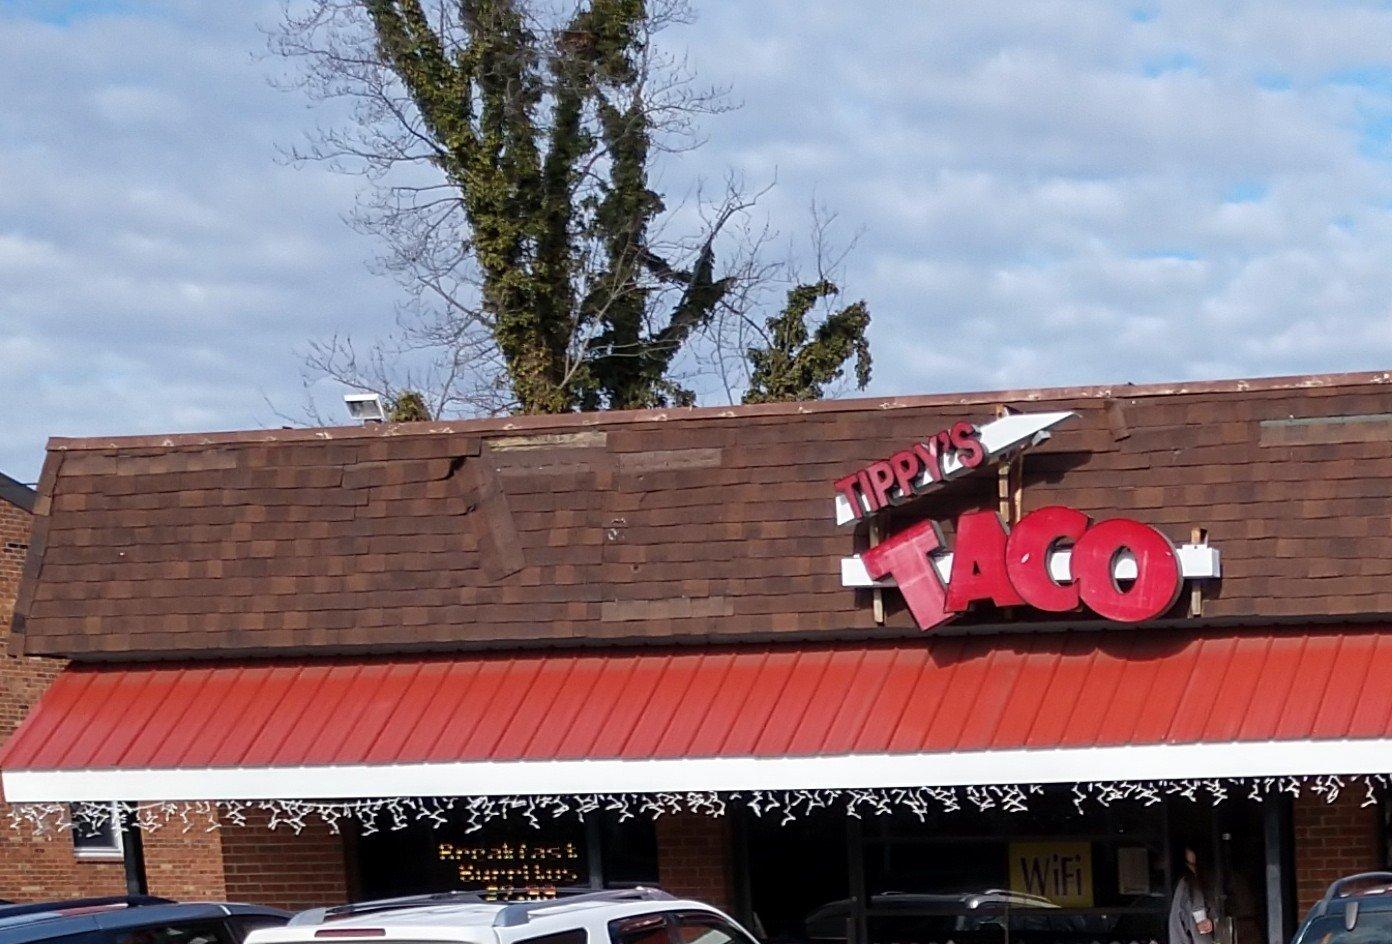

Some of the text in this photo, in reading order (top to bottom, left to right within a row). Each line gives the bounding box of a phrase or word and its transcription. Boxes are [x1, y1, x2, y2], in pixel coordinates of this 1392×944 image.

[834, 421, 984, 519] TIPPY'S
[861, 505, 1180, 631] TACO
[439, 842, 578, 860] Breakfast
[459, 864, 577, 882] Burritos
[1020, 854, 1082, 896] WiFi
